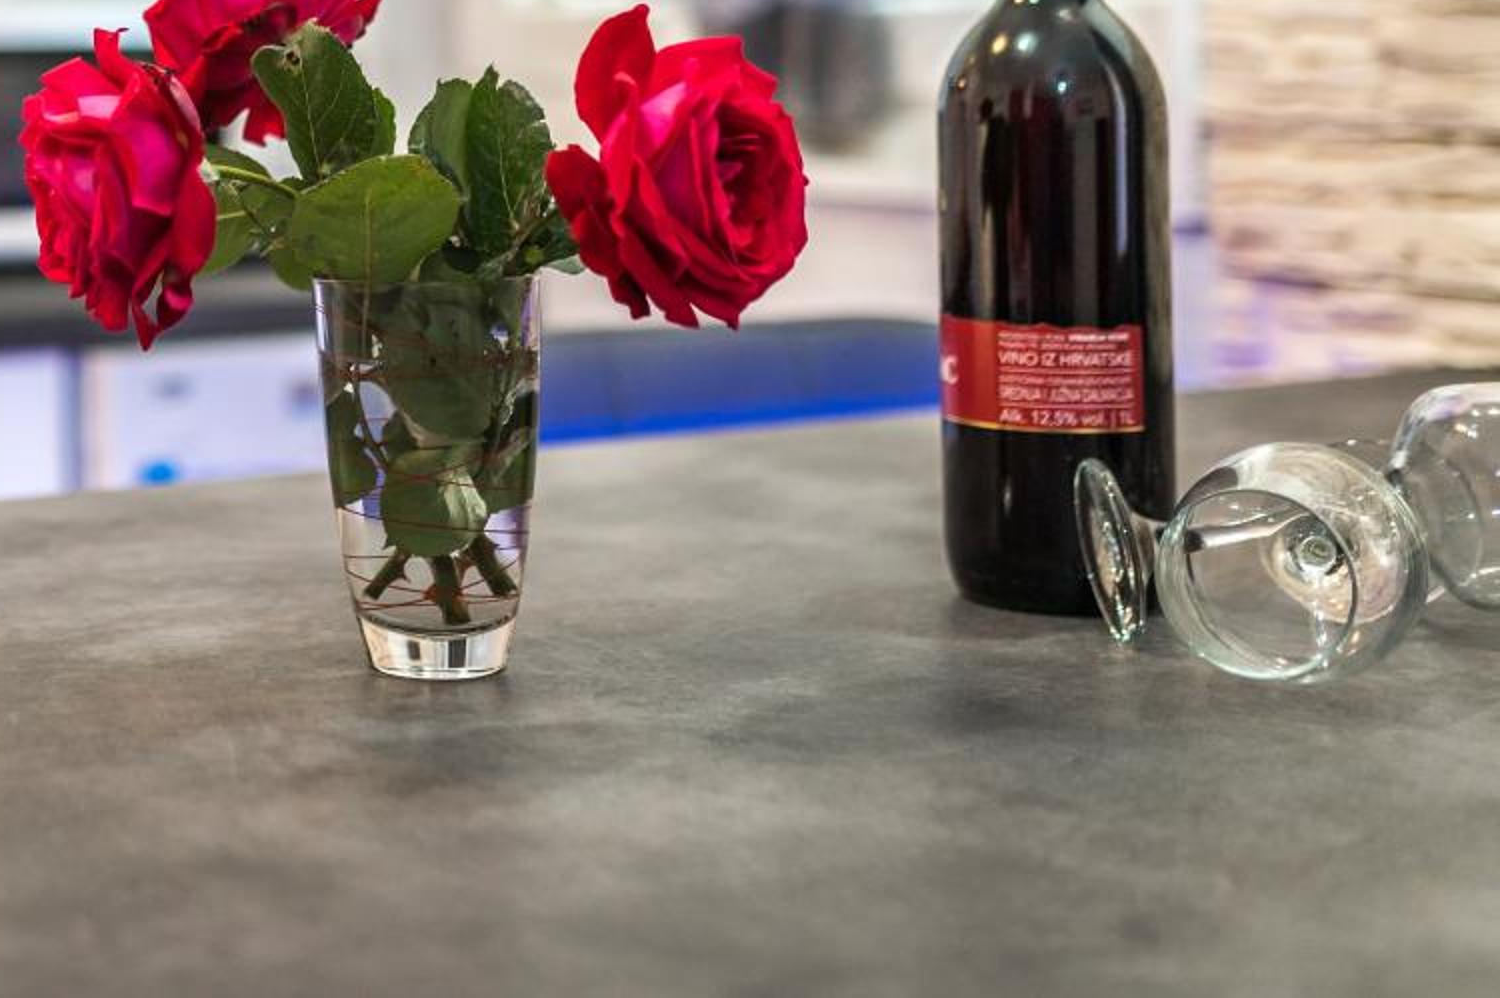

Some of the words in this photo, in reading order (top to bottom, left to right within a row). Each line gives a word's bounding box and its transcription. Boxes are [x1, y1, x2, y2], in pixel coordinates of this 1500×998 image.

[998, 351, 1039, 367] VINO
[1041, 352, 1057, 367] IZ
[1059, 351, 1132, 367] HRVATSKE
